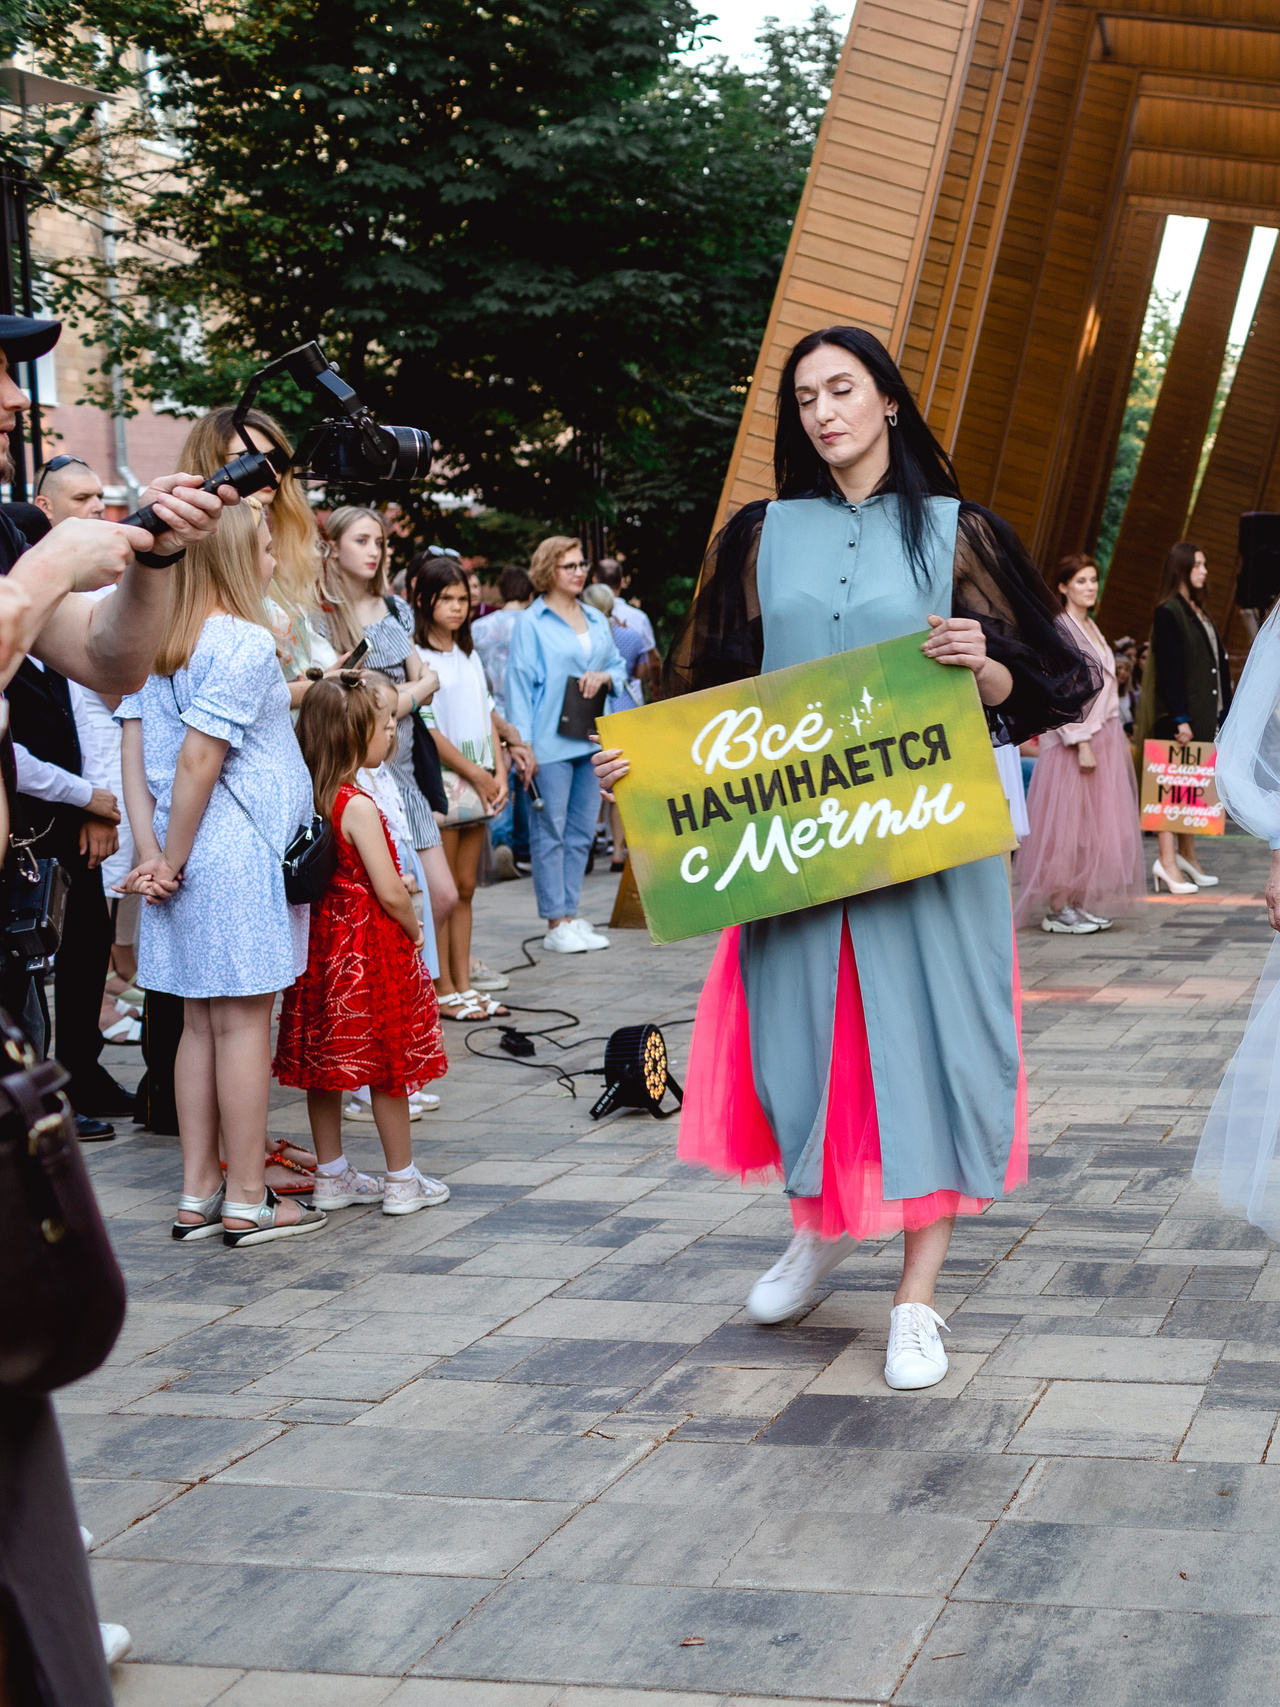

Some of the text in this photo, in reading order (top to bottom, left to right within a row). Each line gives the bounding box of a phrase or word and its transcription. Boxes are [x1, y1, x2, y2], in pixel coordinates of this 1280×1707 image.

[691, 702, 833, 774] Всё
[1168, 745, 1202, 766] МЫ
[667, 723, 951, 836] НАЧИНАЕТСЯ
[1147, 763, 1216, 777] не сможе
[1156, 774, 1212, 787] спасти
[1143, 801, 1223, 821] не изменив
[1183, 816, 1209, 827] его
[680, 782, 965, 892] с Мечты
